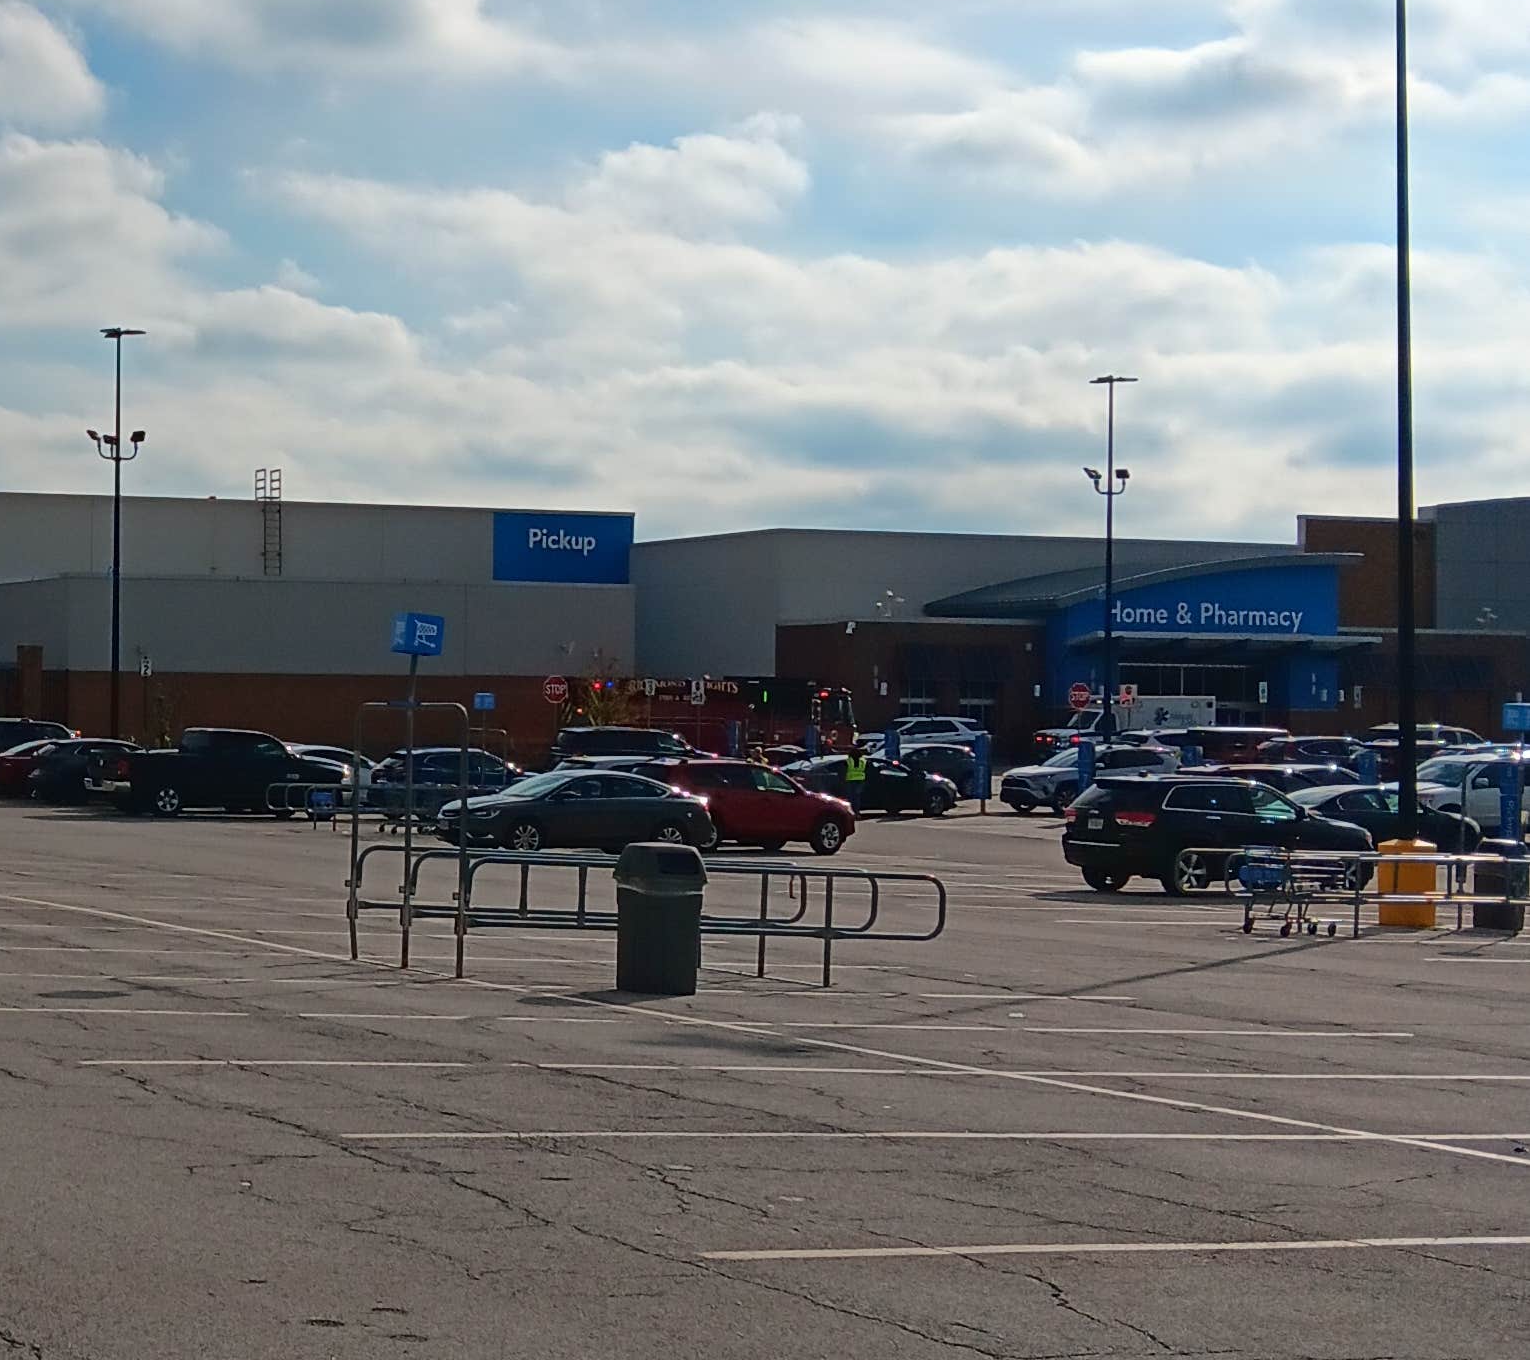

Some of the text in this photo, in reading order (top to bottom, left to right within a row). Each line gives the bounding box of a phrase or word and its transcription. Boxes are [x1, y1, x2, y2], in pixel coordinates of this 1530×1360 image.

[528, 528, 596, 556] Pickup
[1176, 602, 1192, 625] &
[1200, 602, 1303, 633] Pharmacy
[545, 684, 566, 695] STOP
[1071, 691, 1089, 701] STOP
